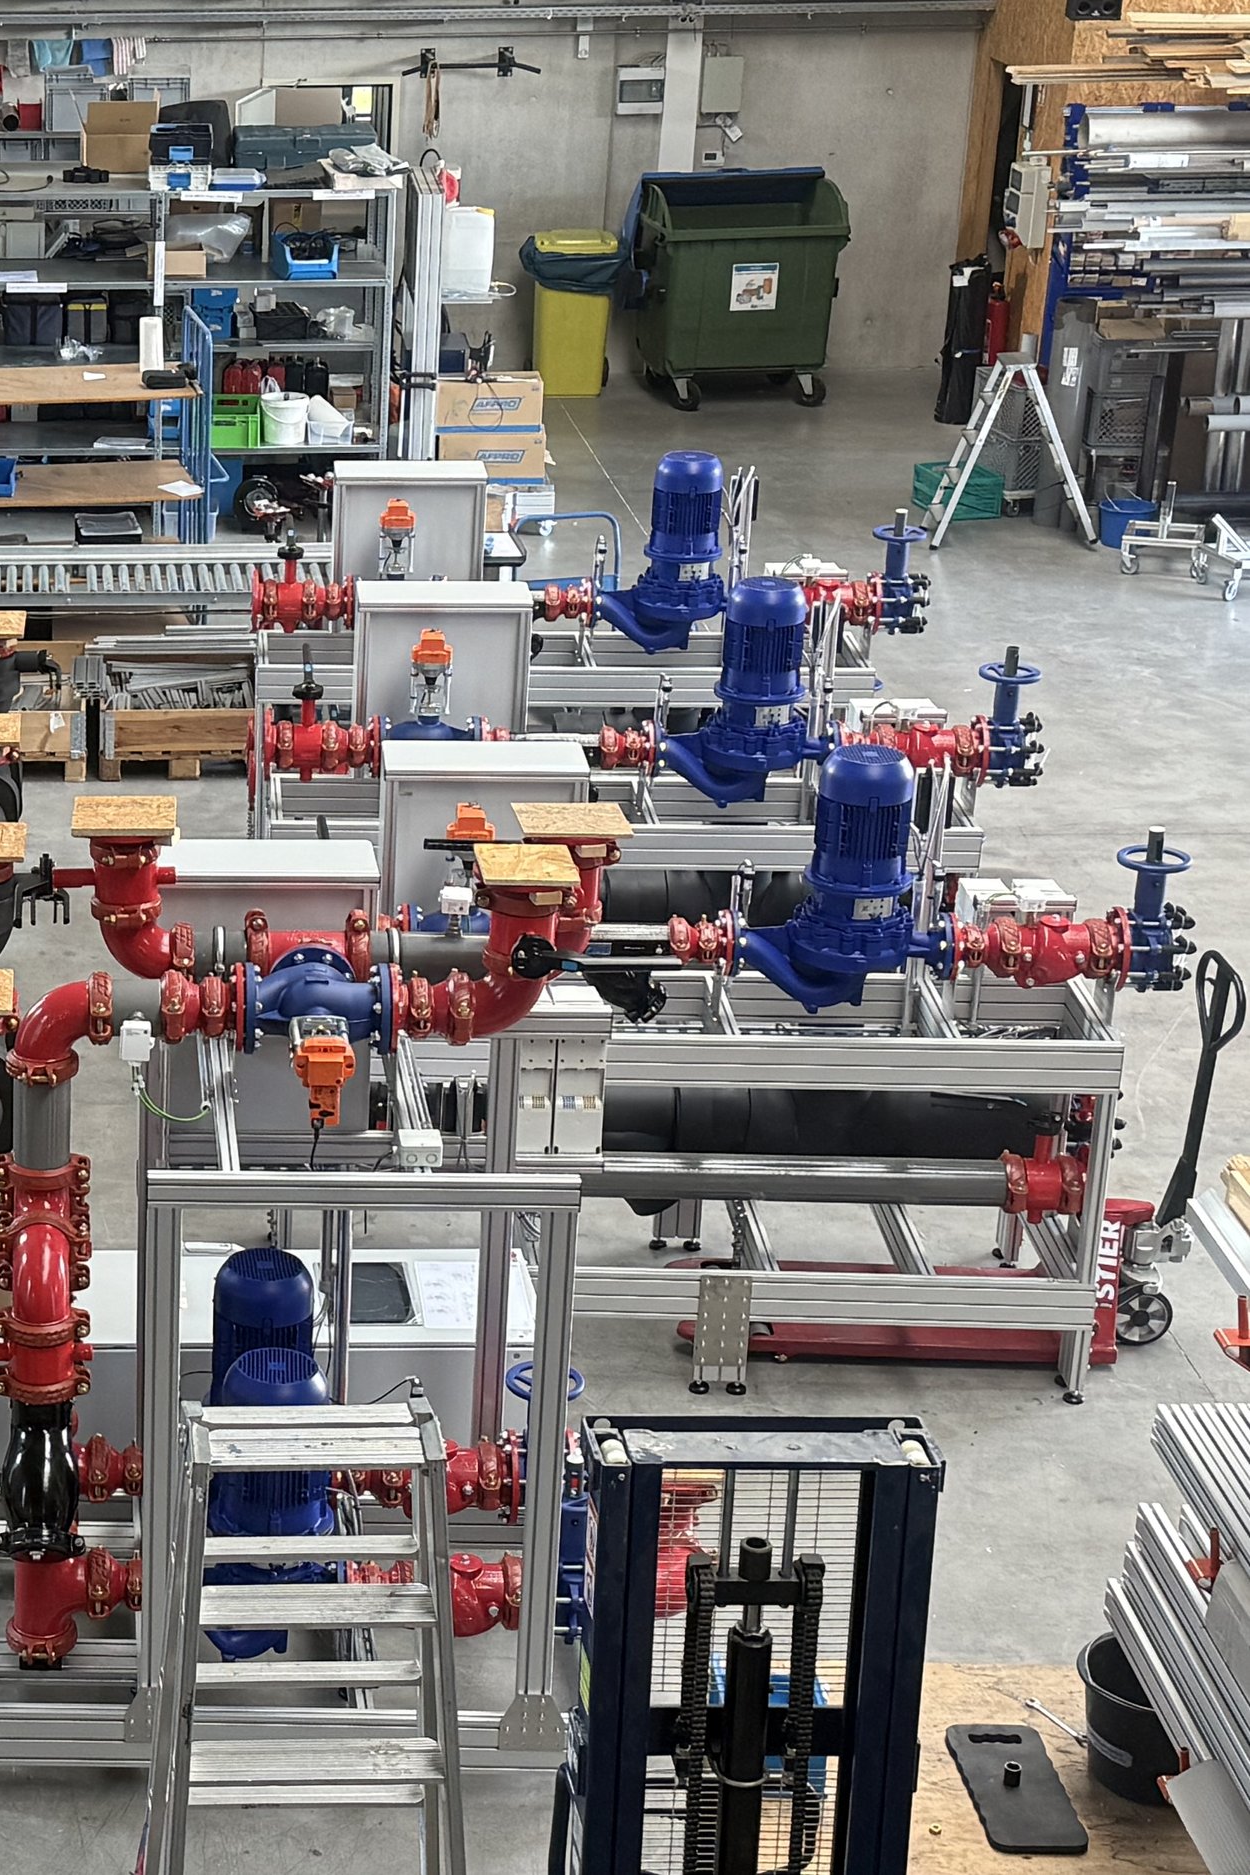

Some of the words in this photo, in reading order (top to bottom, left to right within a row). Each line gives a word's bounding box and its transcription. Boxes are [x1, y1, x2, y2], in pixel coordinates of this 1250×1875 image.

[476, 399, 517, 409] AFPRO
[478, 452, 521, 461] AFPRO
[1095, 1219, 1121, 1301] STIER
